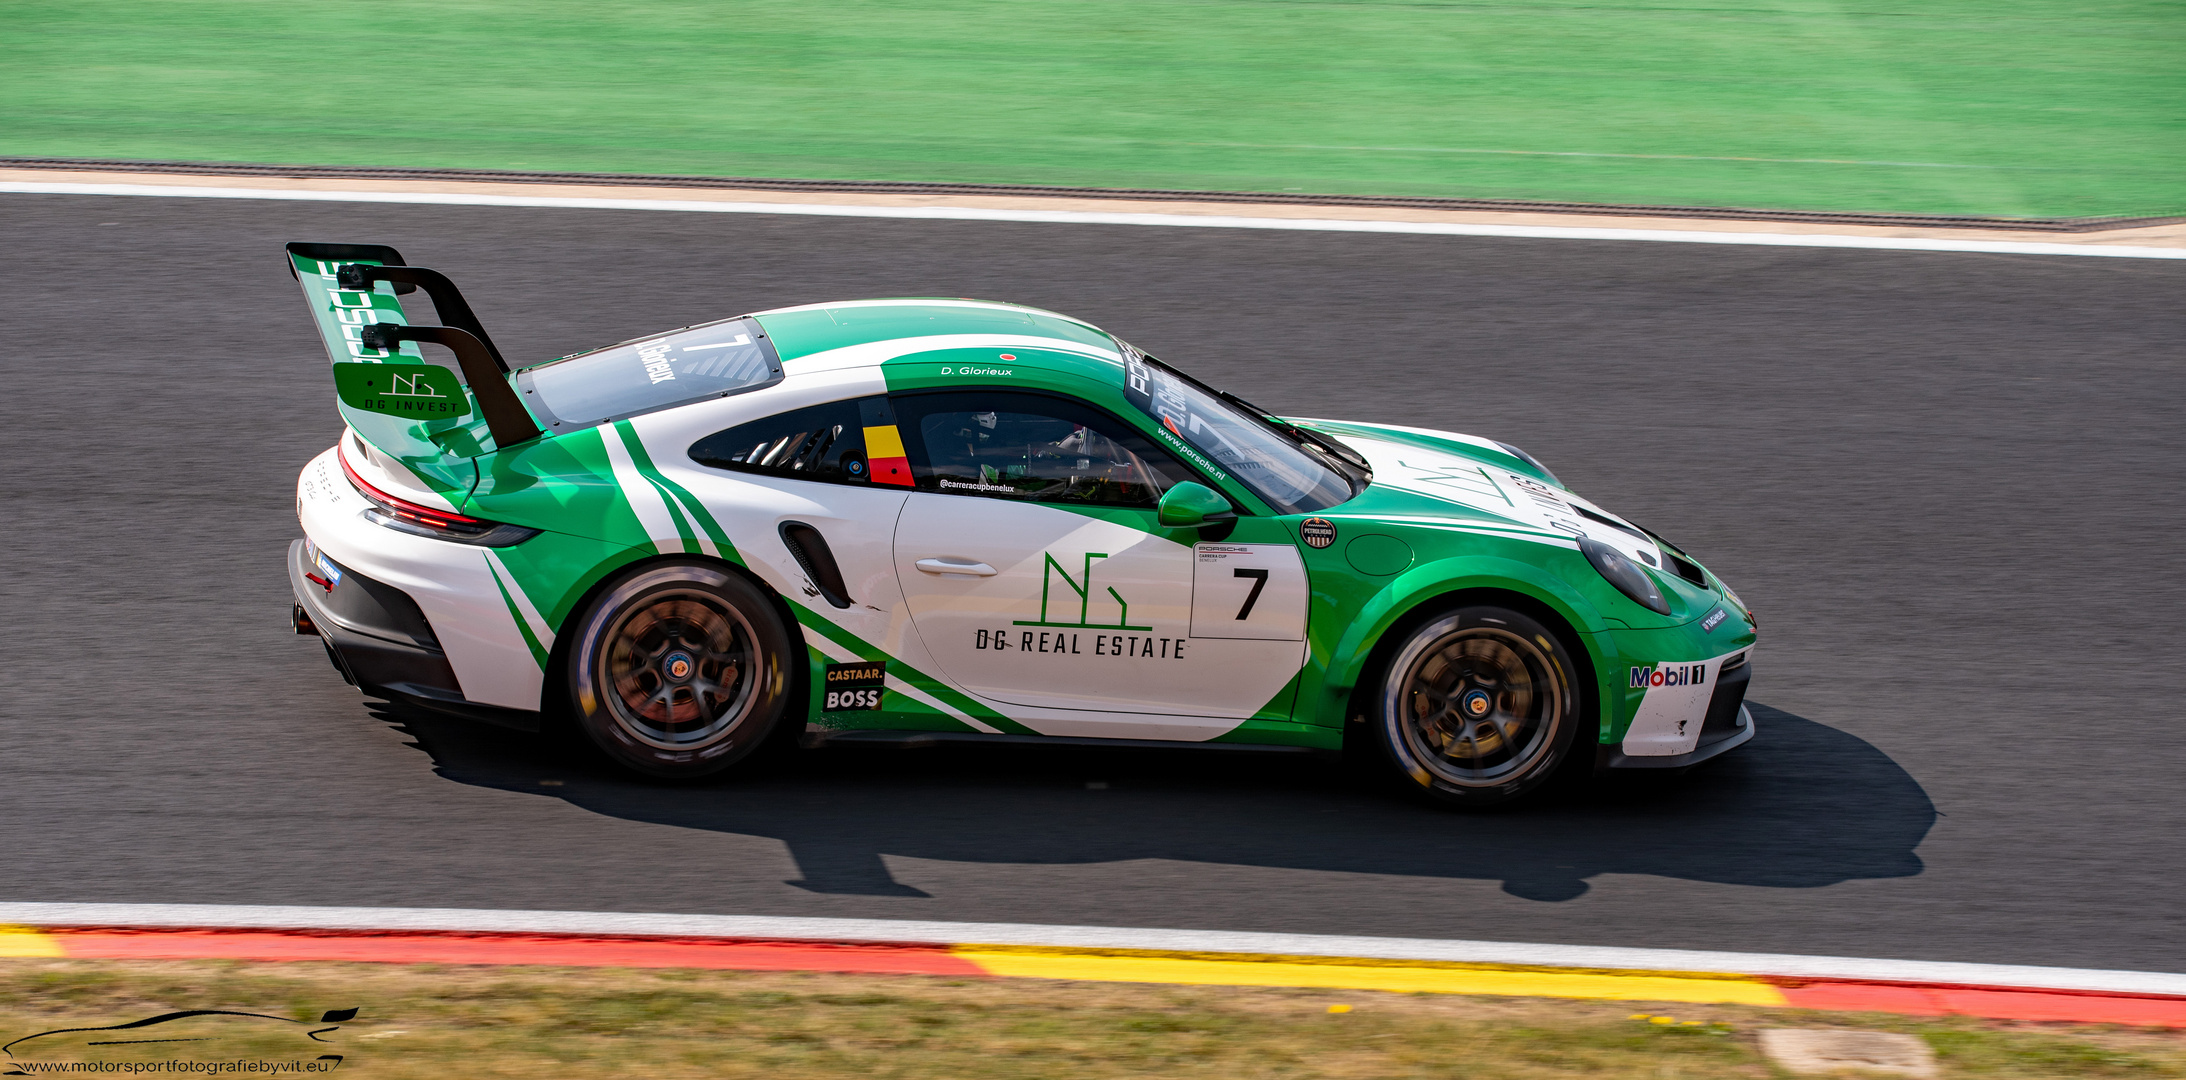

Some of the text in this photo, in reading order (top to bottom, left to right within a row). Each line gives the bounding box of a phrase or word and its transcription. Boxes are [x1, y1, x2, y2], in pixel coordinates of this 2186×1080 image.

[682, 334, 751, 351] 7
[637, 344, 677, 385] Glorieux
[941, 366, 1012, 376] D. Glorieux
[365, 399, 458, 413] DG INVEST
[1188, 412, 1245, 461] 7
[1157, 427, 1226, 481] www.porsche.nl
[940, 479, 1014, 492] @carreracupbenelux
[1233, 567, 1269, 621] 7
[976, 629, 1186, 659] DG REAL ESTATE
[717, 669, 735, 699] bremo
[827, 668, 883, 681] CASTAAR.
[1630, 666, 1689, 688] Mobil
[826, 690, 879, 709] BOSS
